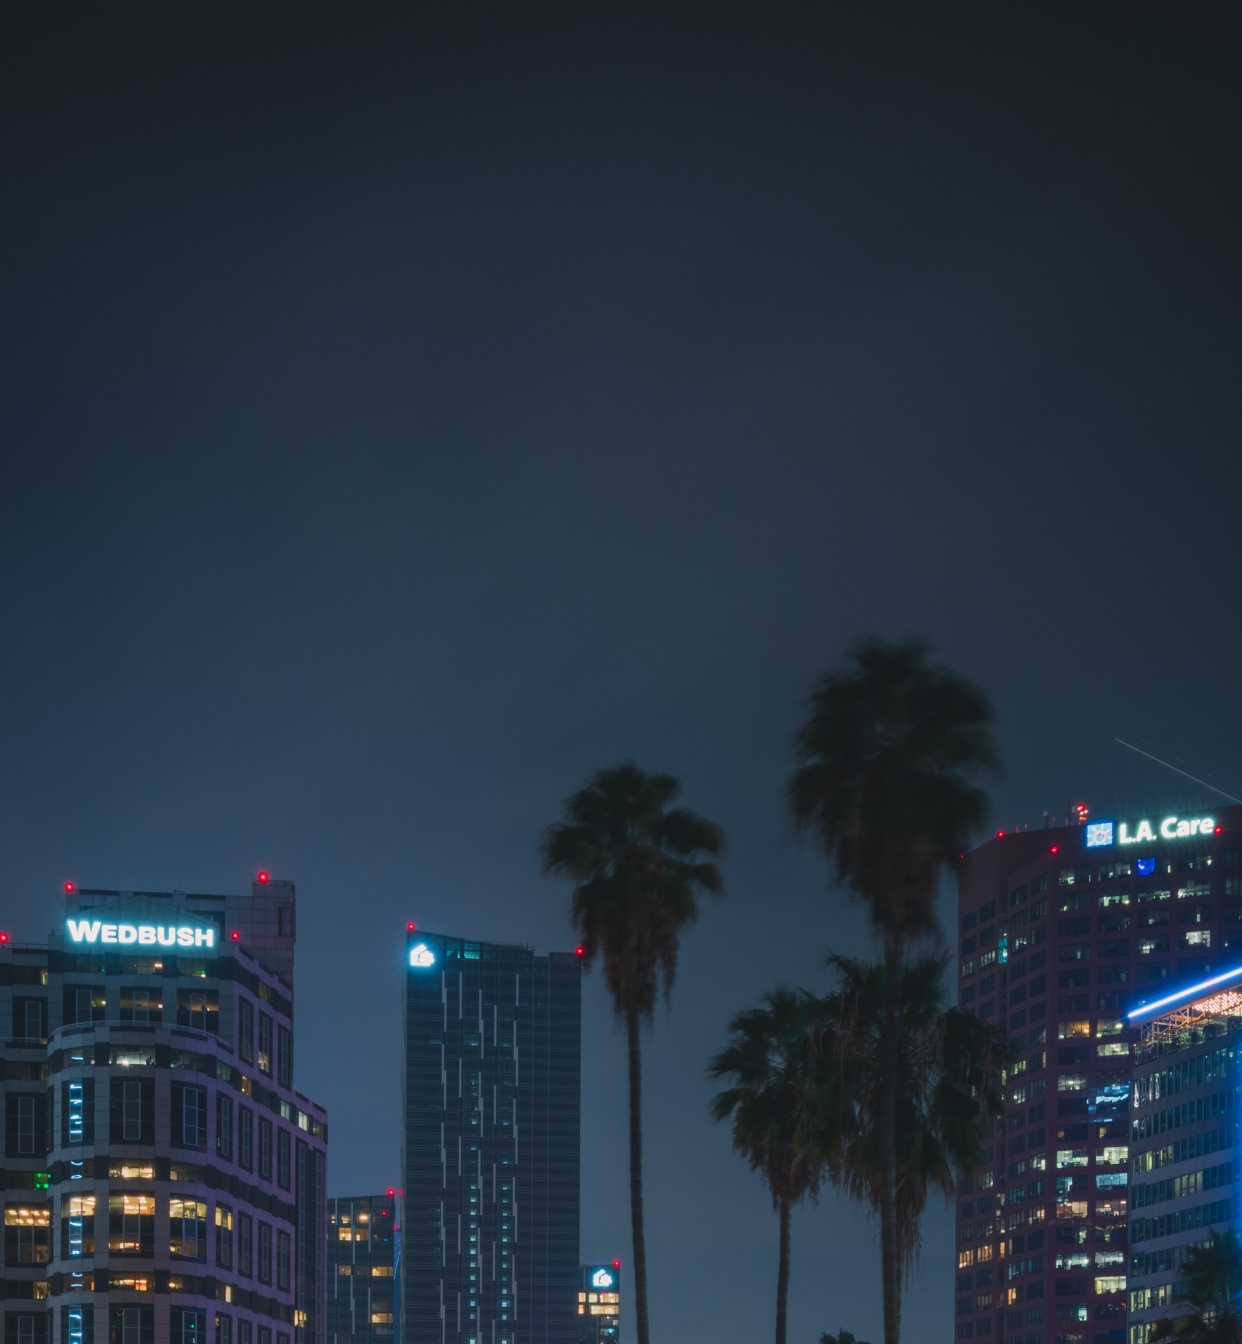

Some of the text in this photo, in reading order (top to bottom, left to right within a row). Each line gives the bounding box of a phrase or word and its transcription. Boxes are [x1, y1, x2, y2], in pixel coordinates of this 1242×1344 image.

[1119, 817, 1215, 844] L.A. Care
[67, 920, 214, 947] WEDBUSH
